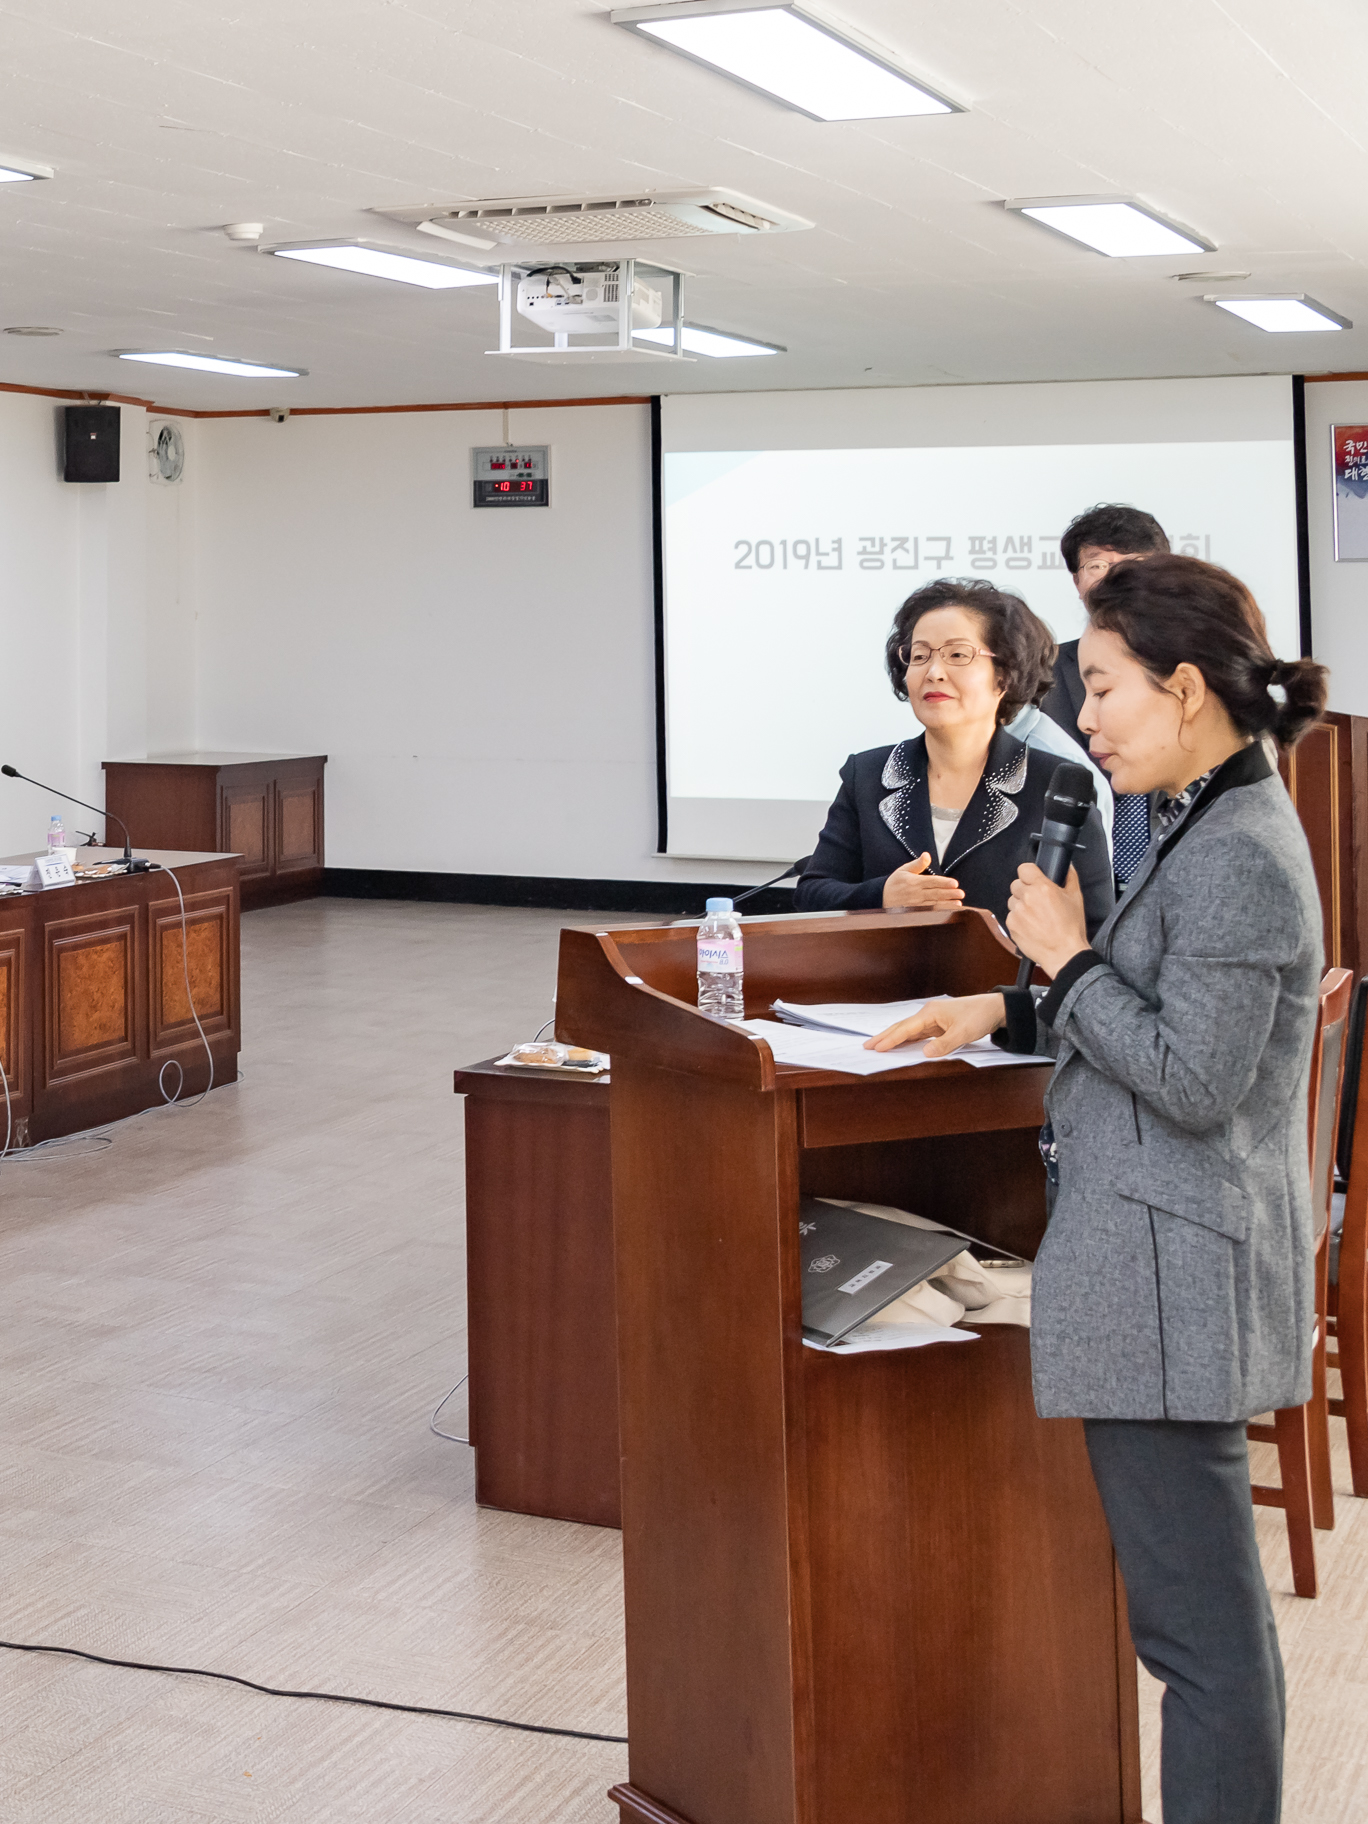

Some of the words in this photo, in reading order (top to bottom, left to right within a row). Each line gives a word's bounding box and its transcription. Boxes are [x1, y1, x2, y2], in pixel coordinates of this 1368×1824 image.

[734, 537, 843, 570] 2019년
[856, 536, 954, 570] 광진구
[699, 949, 728, 959] 아이시스
